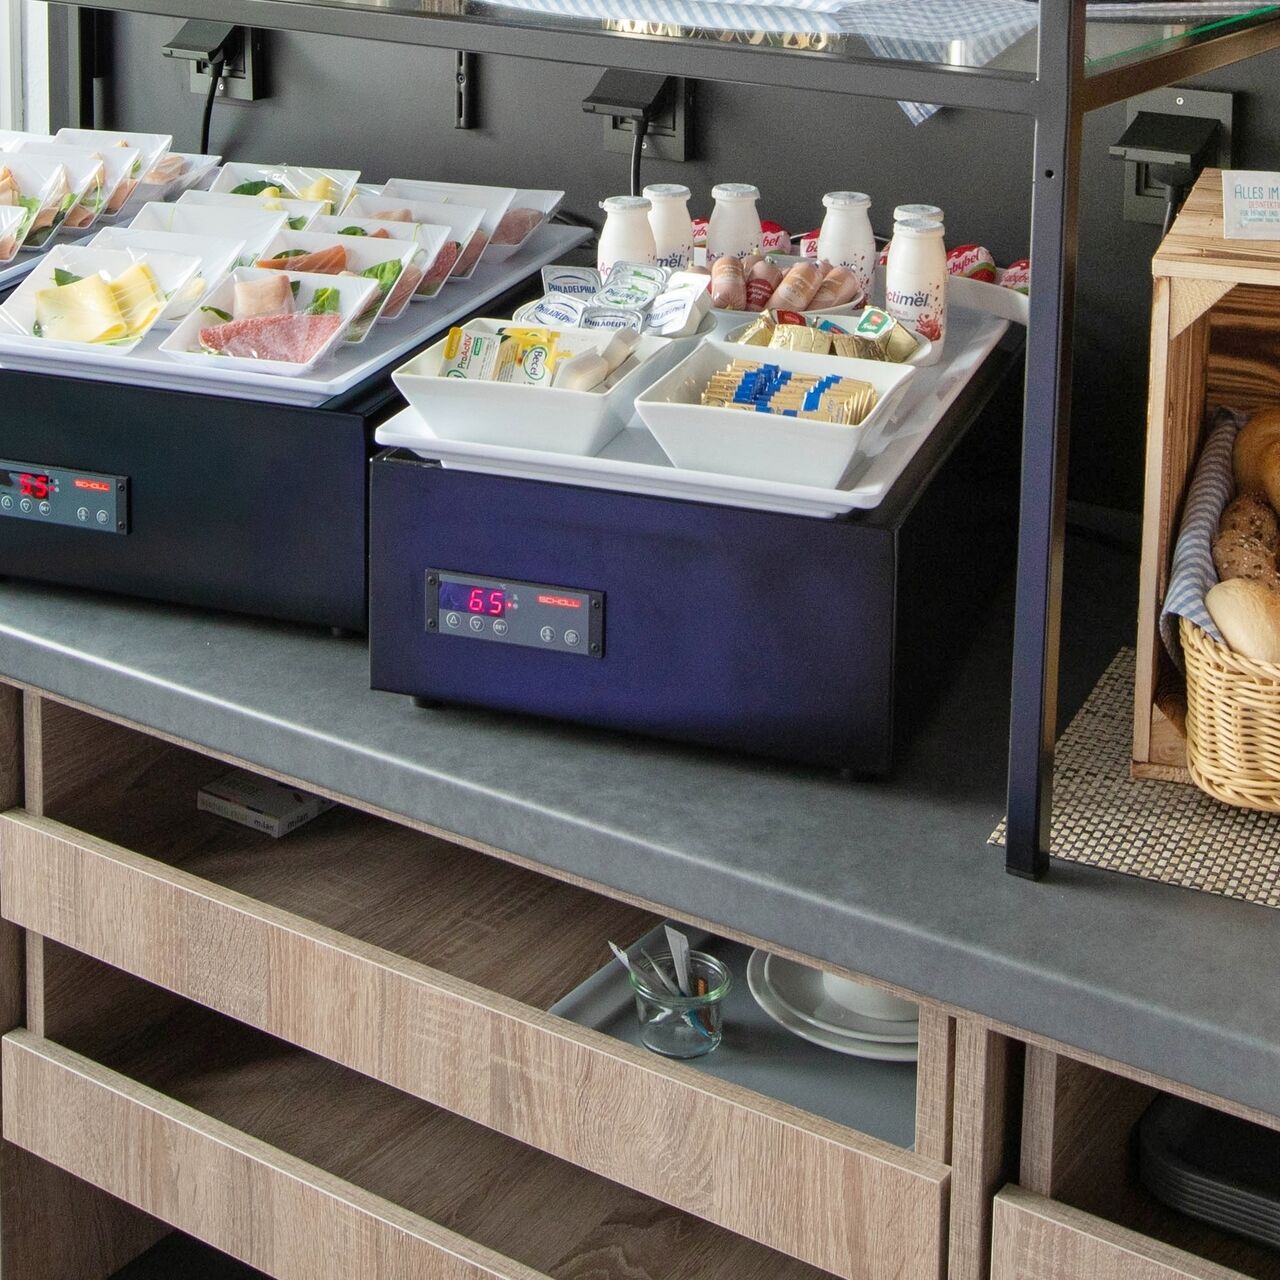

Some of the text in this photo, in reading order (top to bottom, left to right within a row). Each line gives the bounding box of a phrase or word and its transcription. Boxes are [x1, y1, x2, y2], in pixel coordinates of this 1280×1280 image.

[1234, 184, 1264, 200] ALLES
[1268, 187, 1279, 200] IM
[548, 283, 596, 294] PHILADELPHIA
[887, 291, 929, 307] ctimel
[457, 333, 473, 369] ProActiv
[529, 349, 544, 376] Becel
[537, 595, 581, 609] SCHOLL
